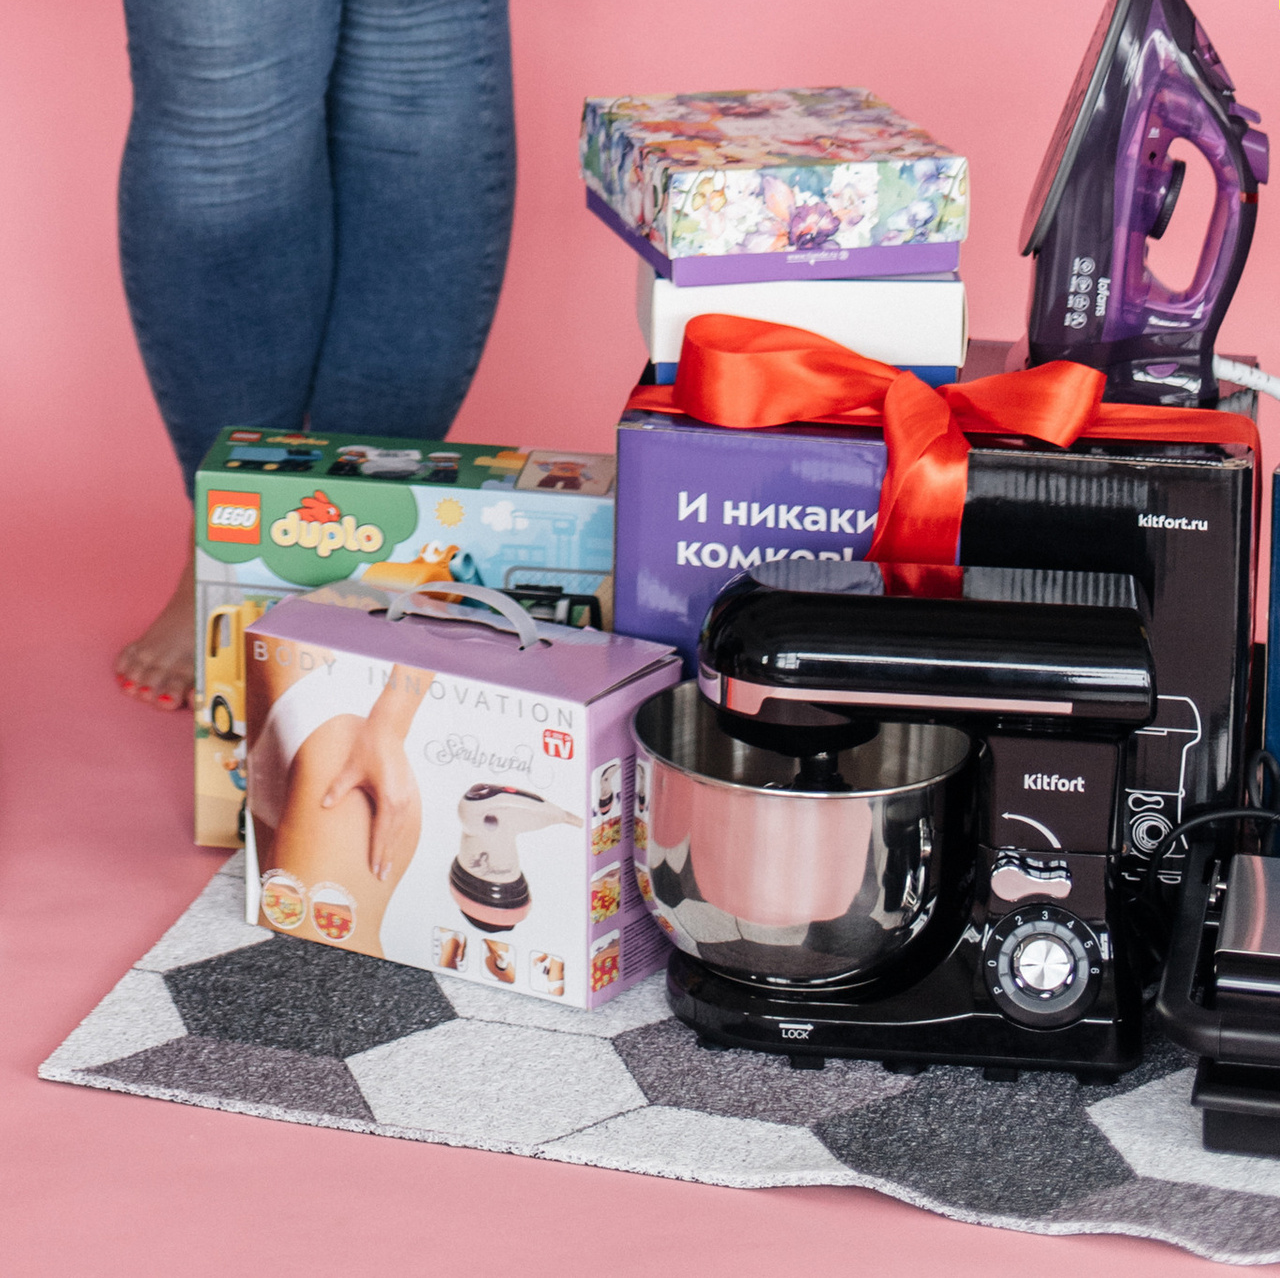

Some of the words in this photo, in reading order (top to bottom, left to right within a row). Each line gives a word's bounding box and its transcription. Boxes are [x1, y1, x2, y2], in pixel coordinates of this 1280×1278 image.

[678, 491, 707, 523] И
[1138, 514, 1208, 531] kitfort.ru
[211, 506, 258, 527] LEGO
[271, 511, 384, 558] duplo
[254, 640, 337, 676] BODY
[368, 666, 573, 729] INNOVATION
[544, 737, 571, 758] TV
[1023, 774, 1085, 792] Kitfort
[1015, 915, 1023, 926] 2
[1042, 910, 1048, 920] 3
[1066, 920, 1075, 929] 4
[1084, 940, 1093, 948] 5
[993, 986, 1003, 994] P
[782, 1029, 809, 1039] LOCK
